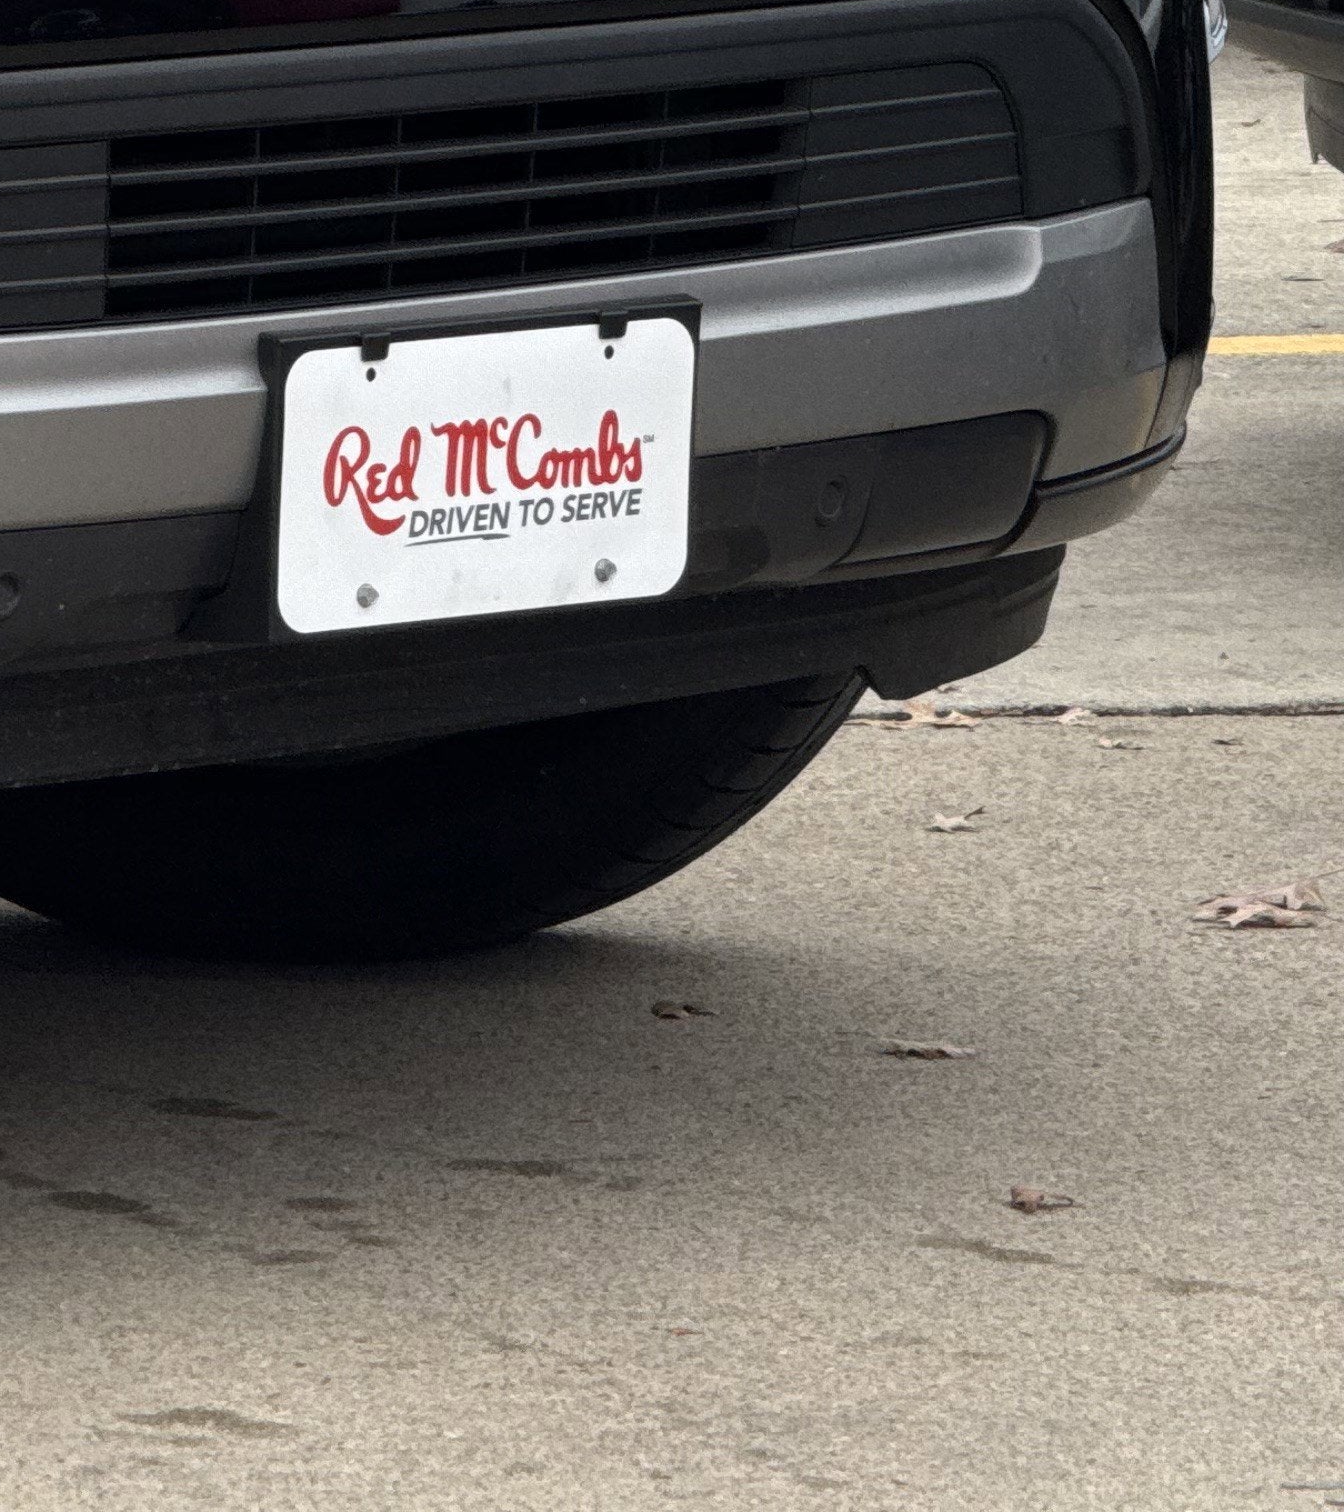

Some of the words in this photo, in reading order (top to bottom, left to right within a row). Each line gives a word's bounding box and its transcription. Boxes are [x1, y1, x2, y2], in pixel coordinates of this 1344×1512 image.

[322, 425, 422, 536] Red
[431, 409, 644, 498] McCombs
[408, 502, 511, 540] DRIVEN
[518, 496, 553, 527] TO
[560, 488, 643, 523] SERVE
